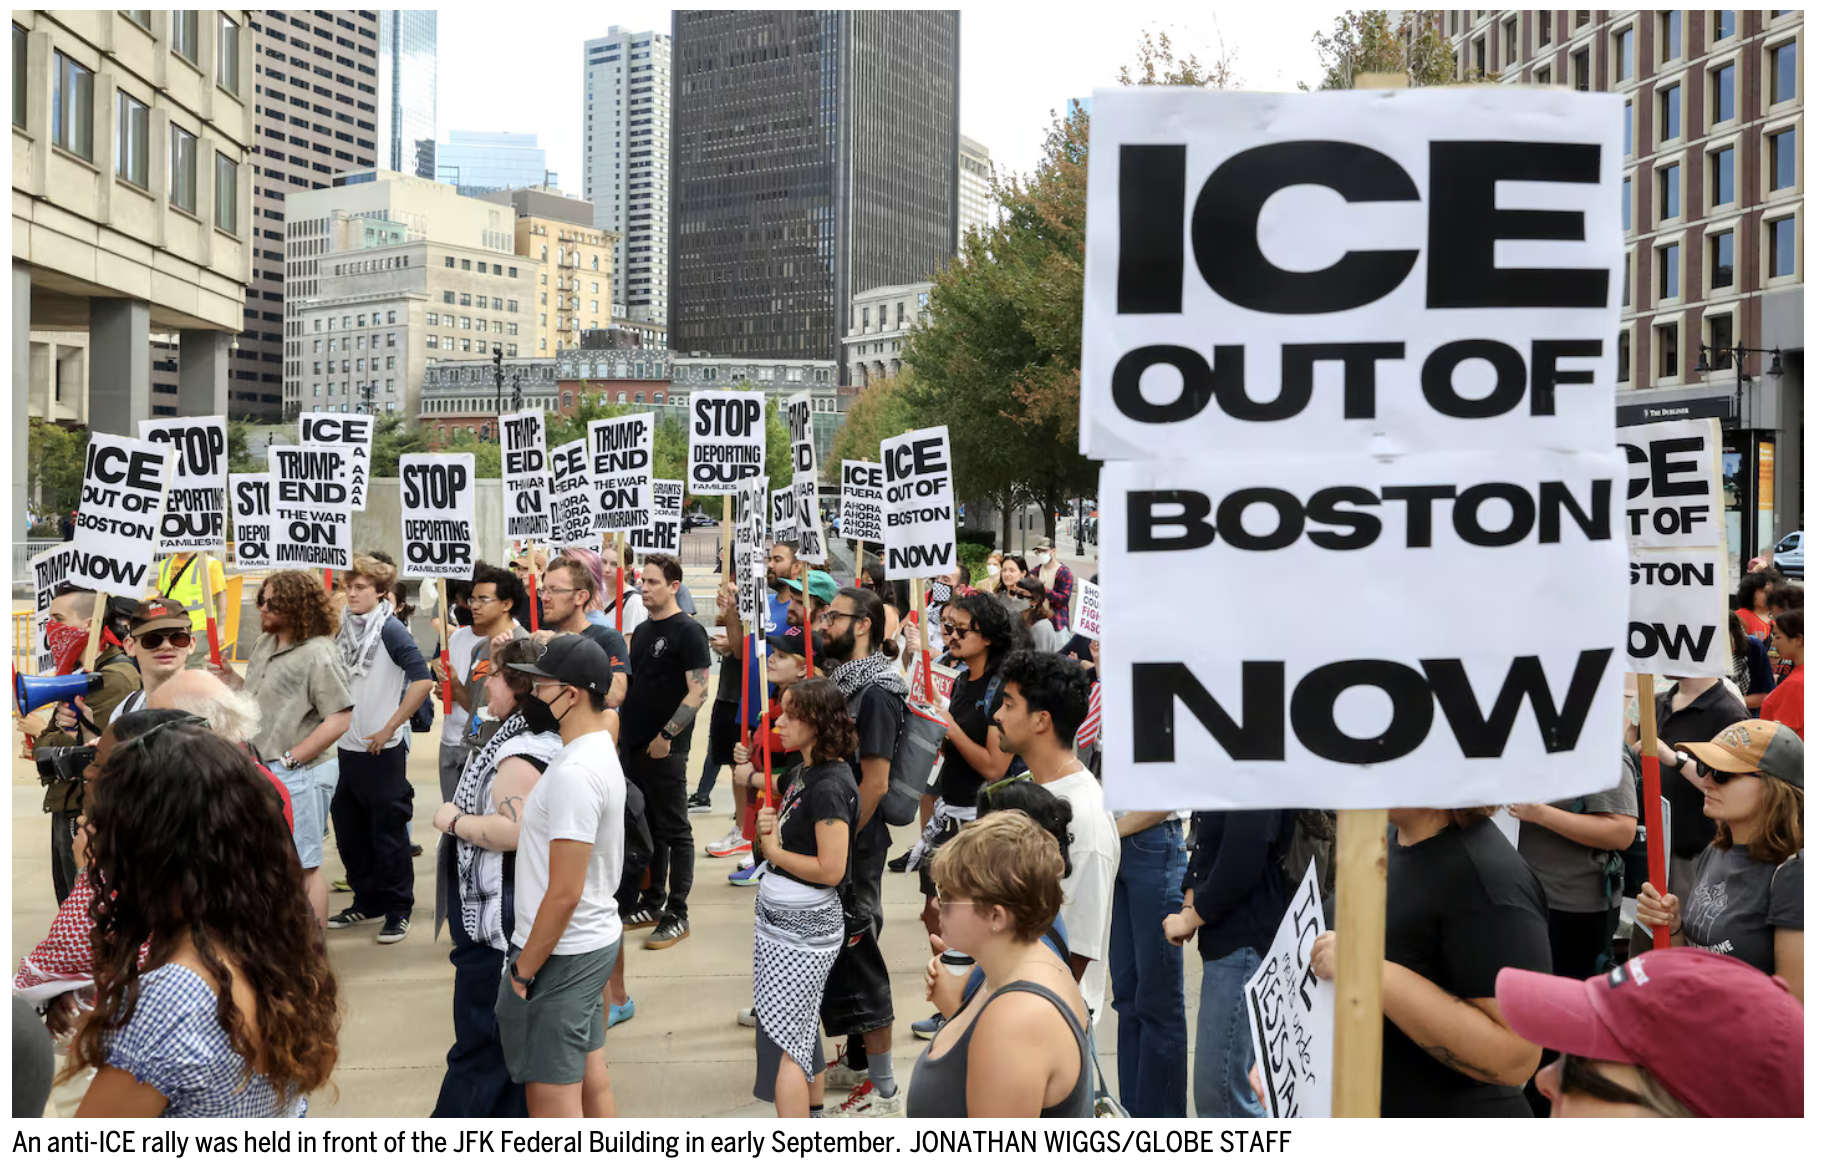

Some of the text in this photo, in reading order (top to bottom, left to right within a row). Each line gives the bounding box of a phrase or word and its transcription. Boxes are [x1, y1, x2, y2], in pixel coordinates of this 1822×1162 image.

[1116, 138, 1610, 315] ICE
[1111, 338, 1604, 424] OUT OF
[695, 398, 760, 437] STOP
[303, 418, 368, 443] ICE
[594, 420, 648, 453] TRUMP:
[276, 451, 345, 480] TRUMP:
[594, 449, 648, 474] END
[694, 445, 761, 463] DEPORTING
[885, 437, 947, 482] ICE
[86, 443, 164, 492] ICE
[844, 465, 882, 488] ICE
[279, 481, 346, 503] END
[403, 464, 466, 509] STOP
[593, 475, 648, 490] THE WAR
[843, 486, 882, 500] FUERA
[886, 477, 948, 504] OUT OF
[82, 485, 159, 514] OUT OF
[166, 488, 223, 512] EPORTIN
[600, 487, 638, 511] ON
[774, 491, 796, 522] STO
[844, 501, 882, 514] AHORA
[77, 513, 154, 541] BOSTON
[160, 513, 222, 537] OUR
[276, 508, 346, 524] THE WAR
[593, 509, 649, 529] IMMIGRANTS
[843, 509, 882, 523] AHORA
[843, 518, 882, 531] AHORA
[887, 506, 950, 527] BOSTON
[1125, 478, 1613, 552] BOSTON
[1653, 505, 1710, 535] OF
[288, 521, 336, 545] ON
[405, 519, 470, 541] DEPORTING
[842, 526, 881, 540] AHORA
[160, 538, 211, 547] FAMILIES
[276, 543, 346, 566] IMMIGRANTS
[407, 542, 471, 564] OUR
[70, 549, 147, 586] NOW
[889, 542, 953, 569] NOW
[407, 565, 471, 573] FAMILIES NOW
[1131, 646, 1615, 765] NOW
[1294, 879, 1318, 1012] ICE
[1293, 1013, 1316, 1085] under
